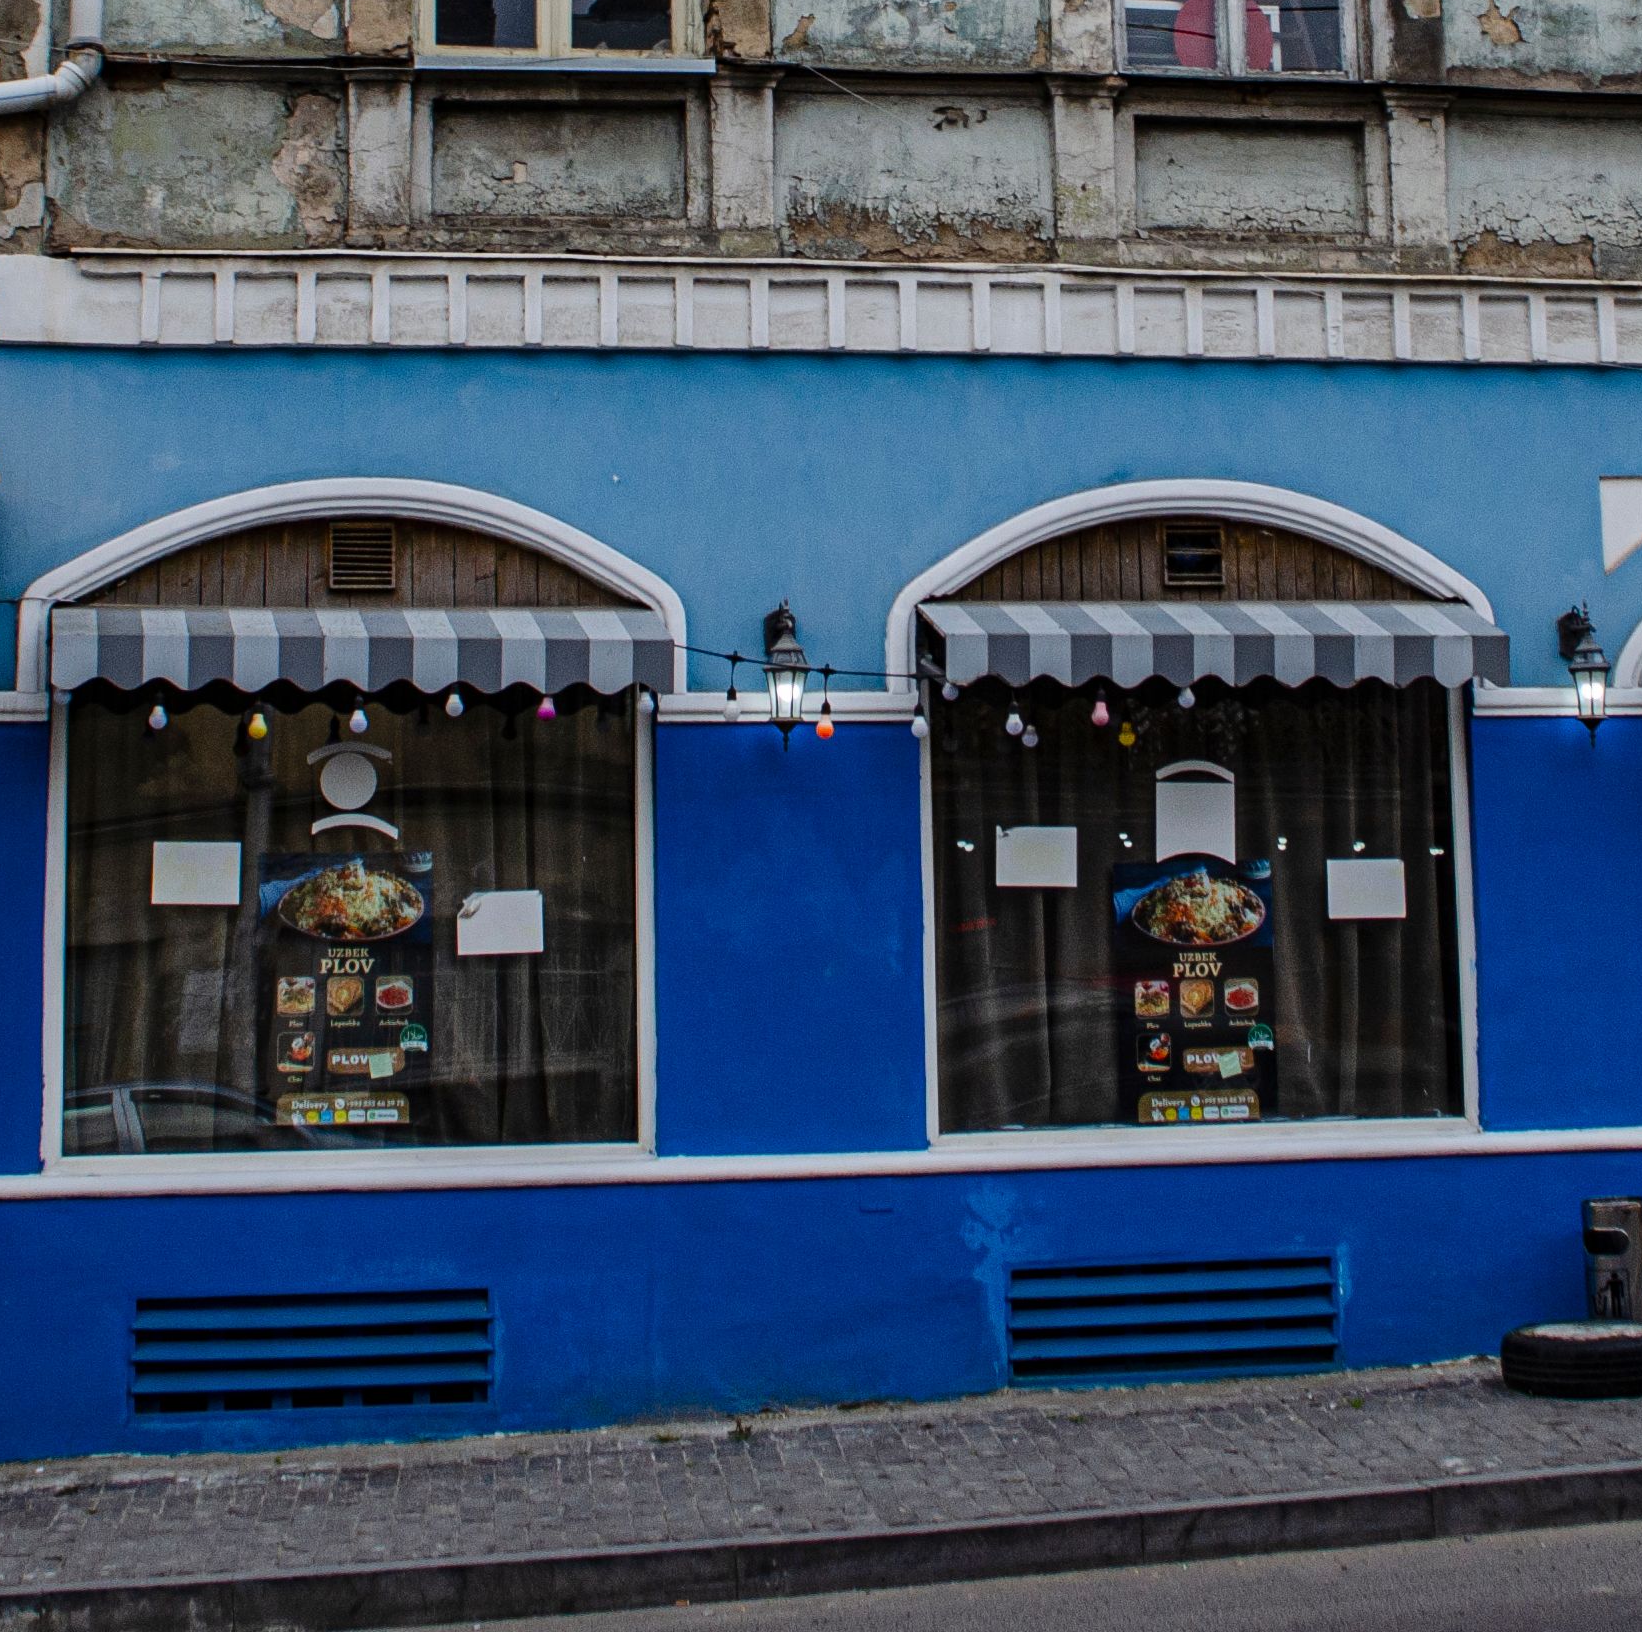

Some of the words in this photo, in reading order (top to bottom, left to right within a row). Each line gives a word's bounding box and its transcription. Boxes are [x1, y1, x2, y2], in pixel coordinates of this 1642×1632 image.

[328, 948, 370, 958] UZBEK
[1179, 952, 1217, 963] UZBEK
[319, 958, 375, 974] PLOV
[1173, 962, 1223, 978] PLOV
[291, 1099, 329, 1111] Delivery
